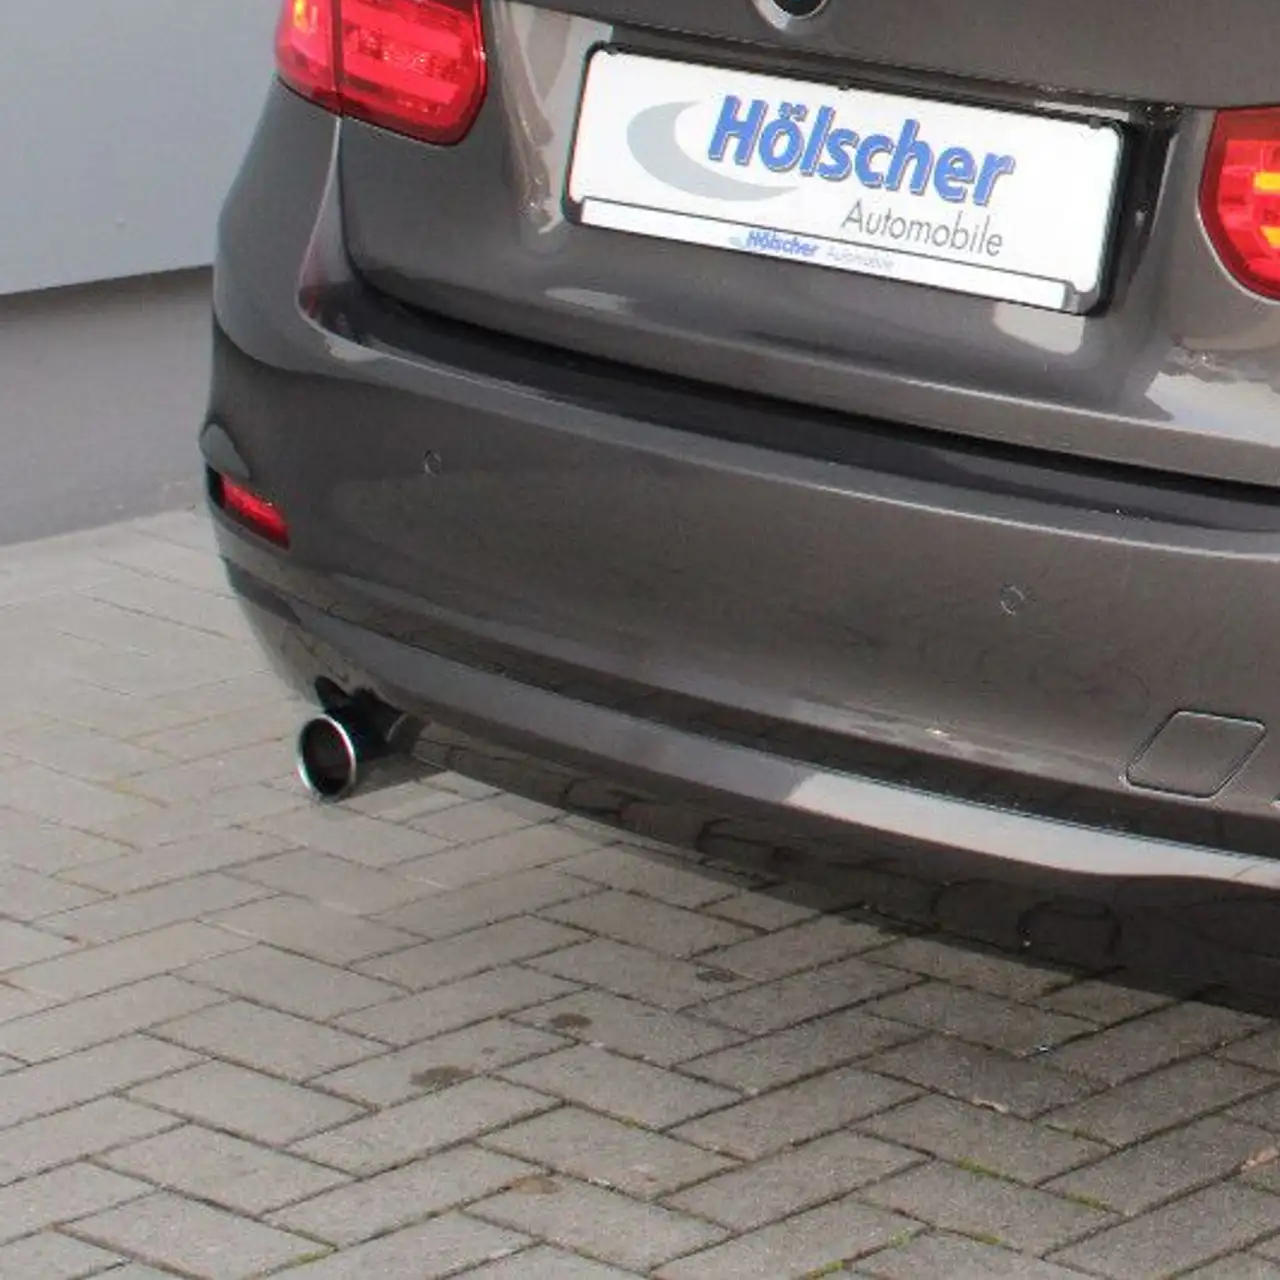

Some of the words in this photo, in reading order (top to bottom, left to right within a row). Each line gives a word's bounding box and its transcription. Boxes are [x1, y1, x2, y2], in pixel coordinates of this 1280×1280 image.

[708, 94, 1016, 206] Hölscher
[747, 230, 820, 257] Hölscher
[841, 199, 1004, 257] Automobile
